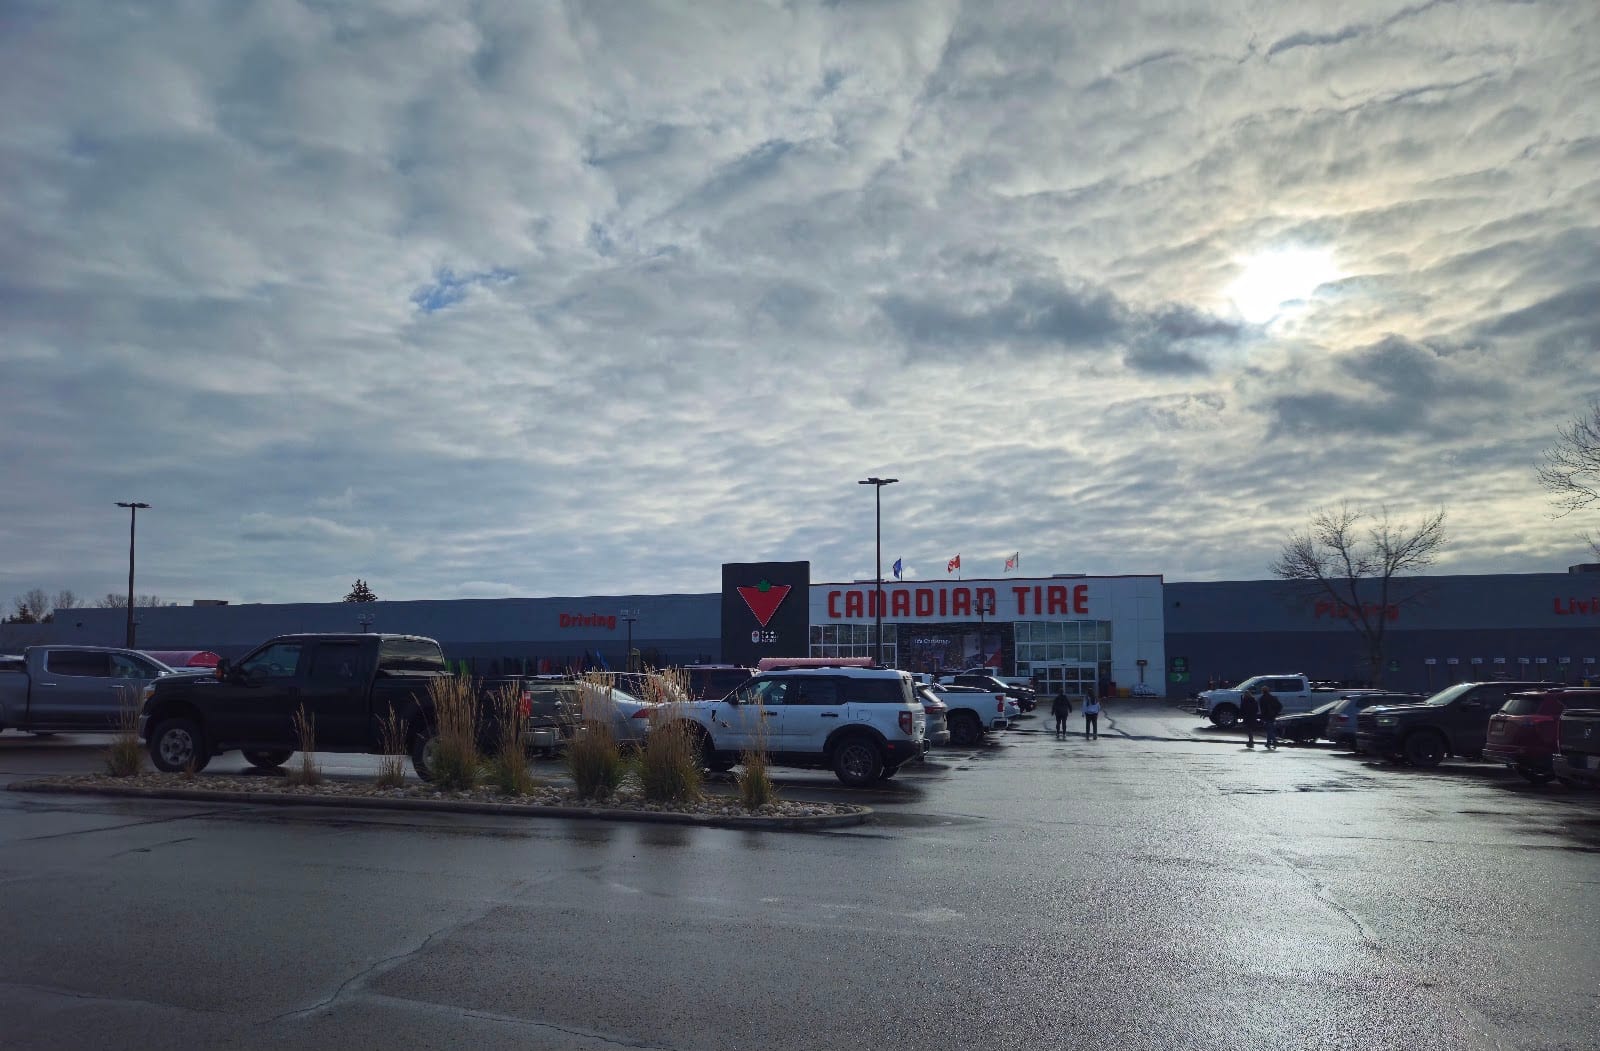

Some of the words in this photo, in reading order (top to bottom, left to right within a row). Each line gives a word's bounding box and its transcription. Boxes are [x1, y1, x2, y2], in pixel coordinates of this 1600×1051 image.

[828, 587, 996, 618] CANADIAN
[1012, 584, 1089, 616] TIRE
[559, 612, 617, 631] Driving
